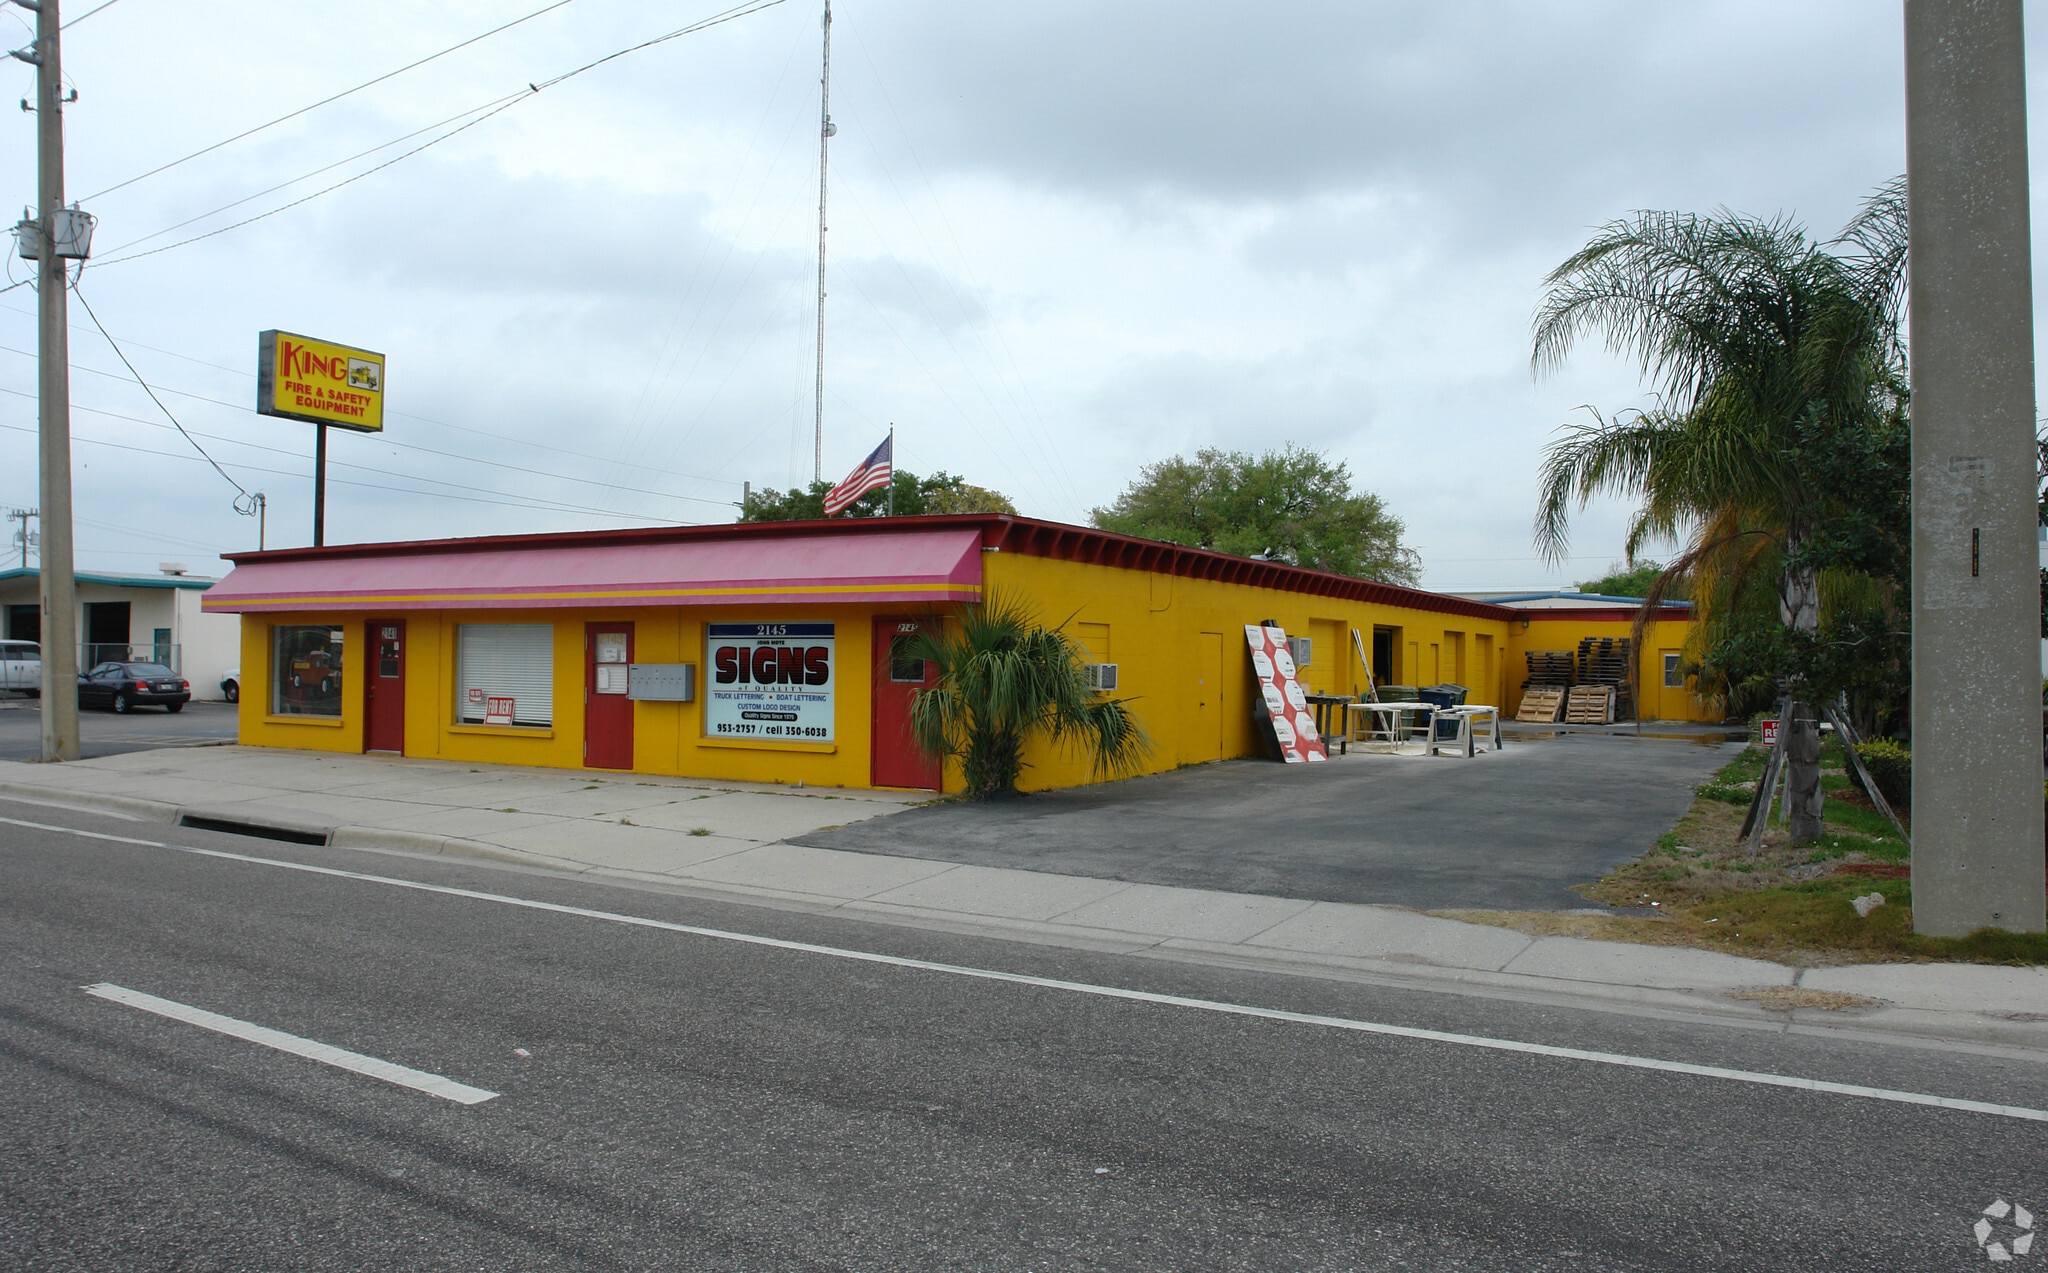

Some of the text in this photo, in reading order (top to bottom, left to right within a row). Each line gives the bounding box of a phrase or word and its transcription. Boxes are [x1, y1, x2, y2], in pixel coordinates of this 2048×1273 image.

[285, 381, 371, 406] FIRE & SAFETY
[296, 395, 365, 417] EQUIPMENT
[757, 624, 786, 635] 2145
[715, 646, 829, 686] SIGNS
[488, 699, 513, 715] FOR RENT
[766, 726, 782, 734] cell
[1764, 728, 1778, 737] RE
